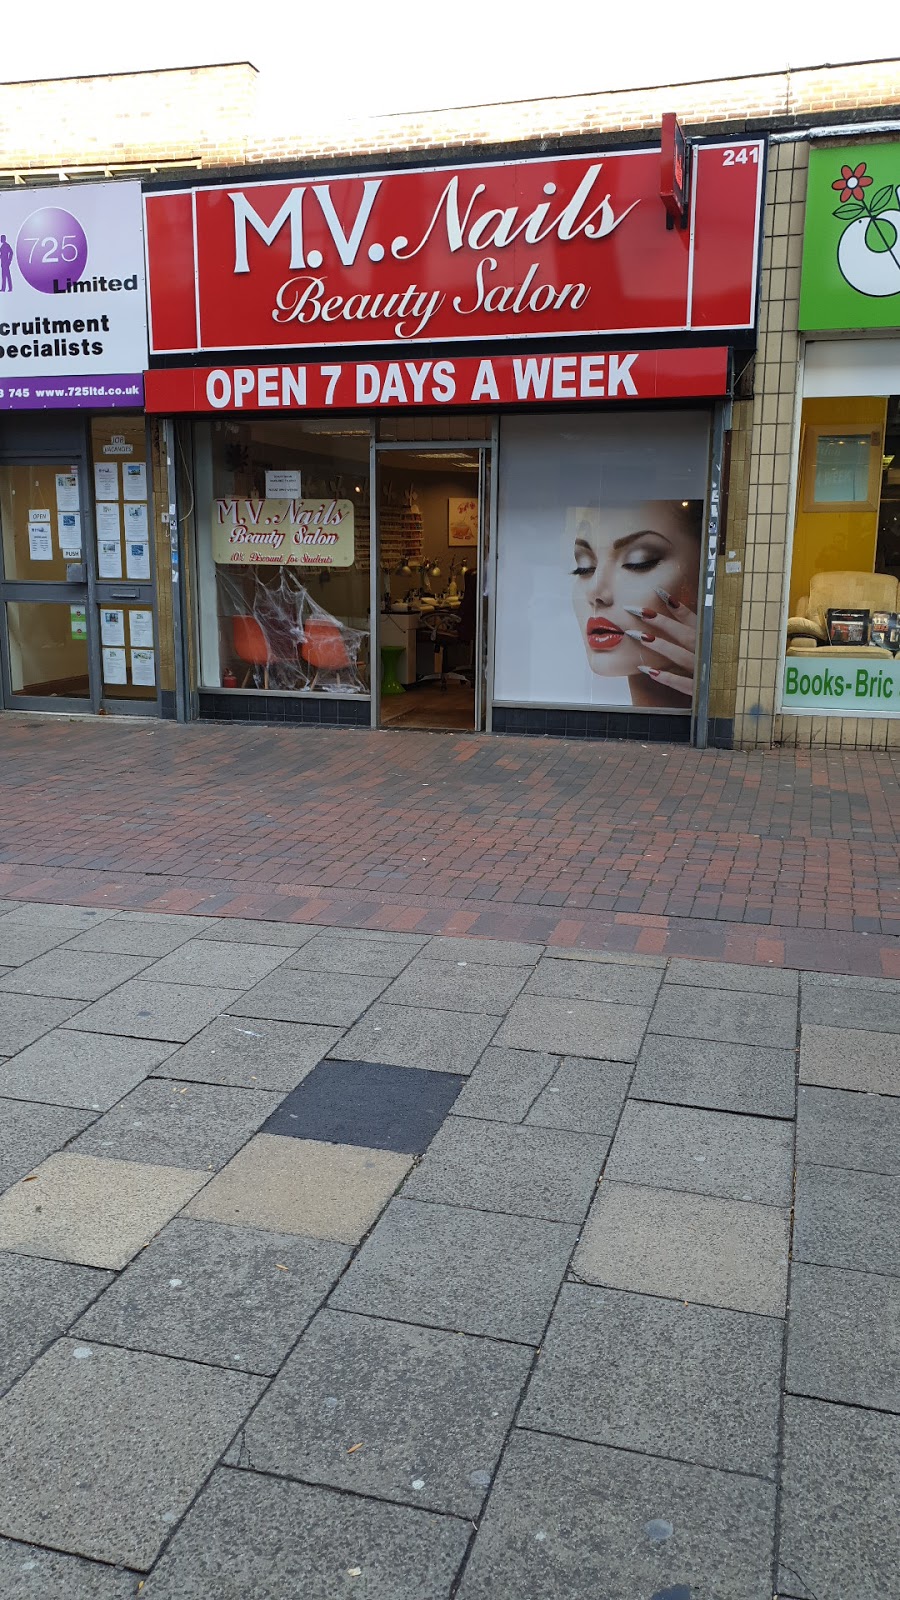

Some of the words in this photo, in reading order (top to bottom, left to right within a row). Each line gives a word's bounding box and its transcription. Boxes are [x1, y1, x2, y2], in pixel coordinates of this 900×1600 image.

[722, 149, 759, 168] 241
[227, 179, 386, 274] M.V.
[390, 162, 643, 261] Nails
[23, 235, 79, 264] 725
[53, 274, 138, 294] Limited
[271, 276, 446, 339] Beauty
[452, 257, 592, 315] Salon
[9, 388, 30, 398] 745
[35, 385, 140, 398] www.725ltd.co.uk
[205, 368, 308, 409] OPEN
[320, 366, 343, 405] 7
[356, 361, 456, 405] DAYS
[471, 360, 500, 403] A
[512, 353, 639, 399] WEEK
[272, 498, 350, 526] Nails
[229, 525, 286, 549] Beauty
[292, 525, 339, 545] Salon
[249, 552, 283, 563] Discount
[284, 554, 298, 565] for
[300, 553, 333, 564] Students
